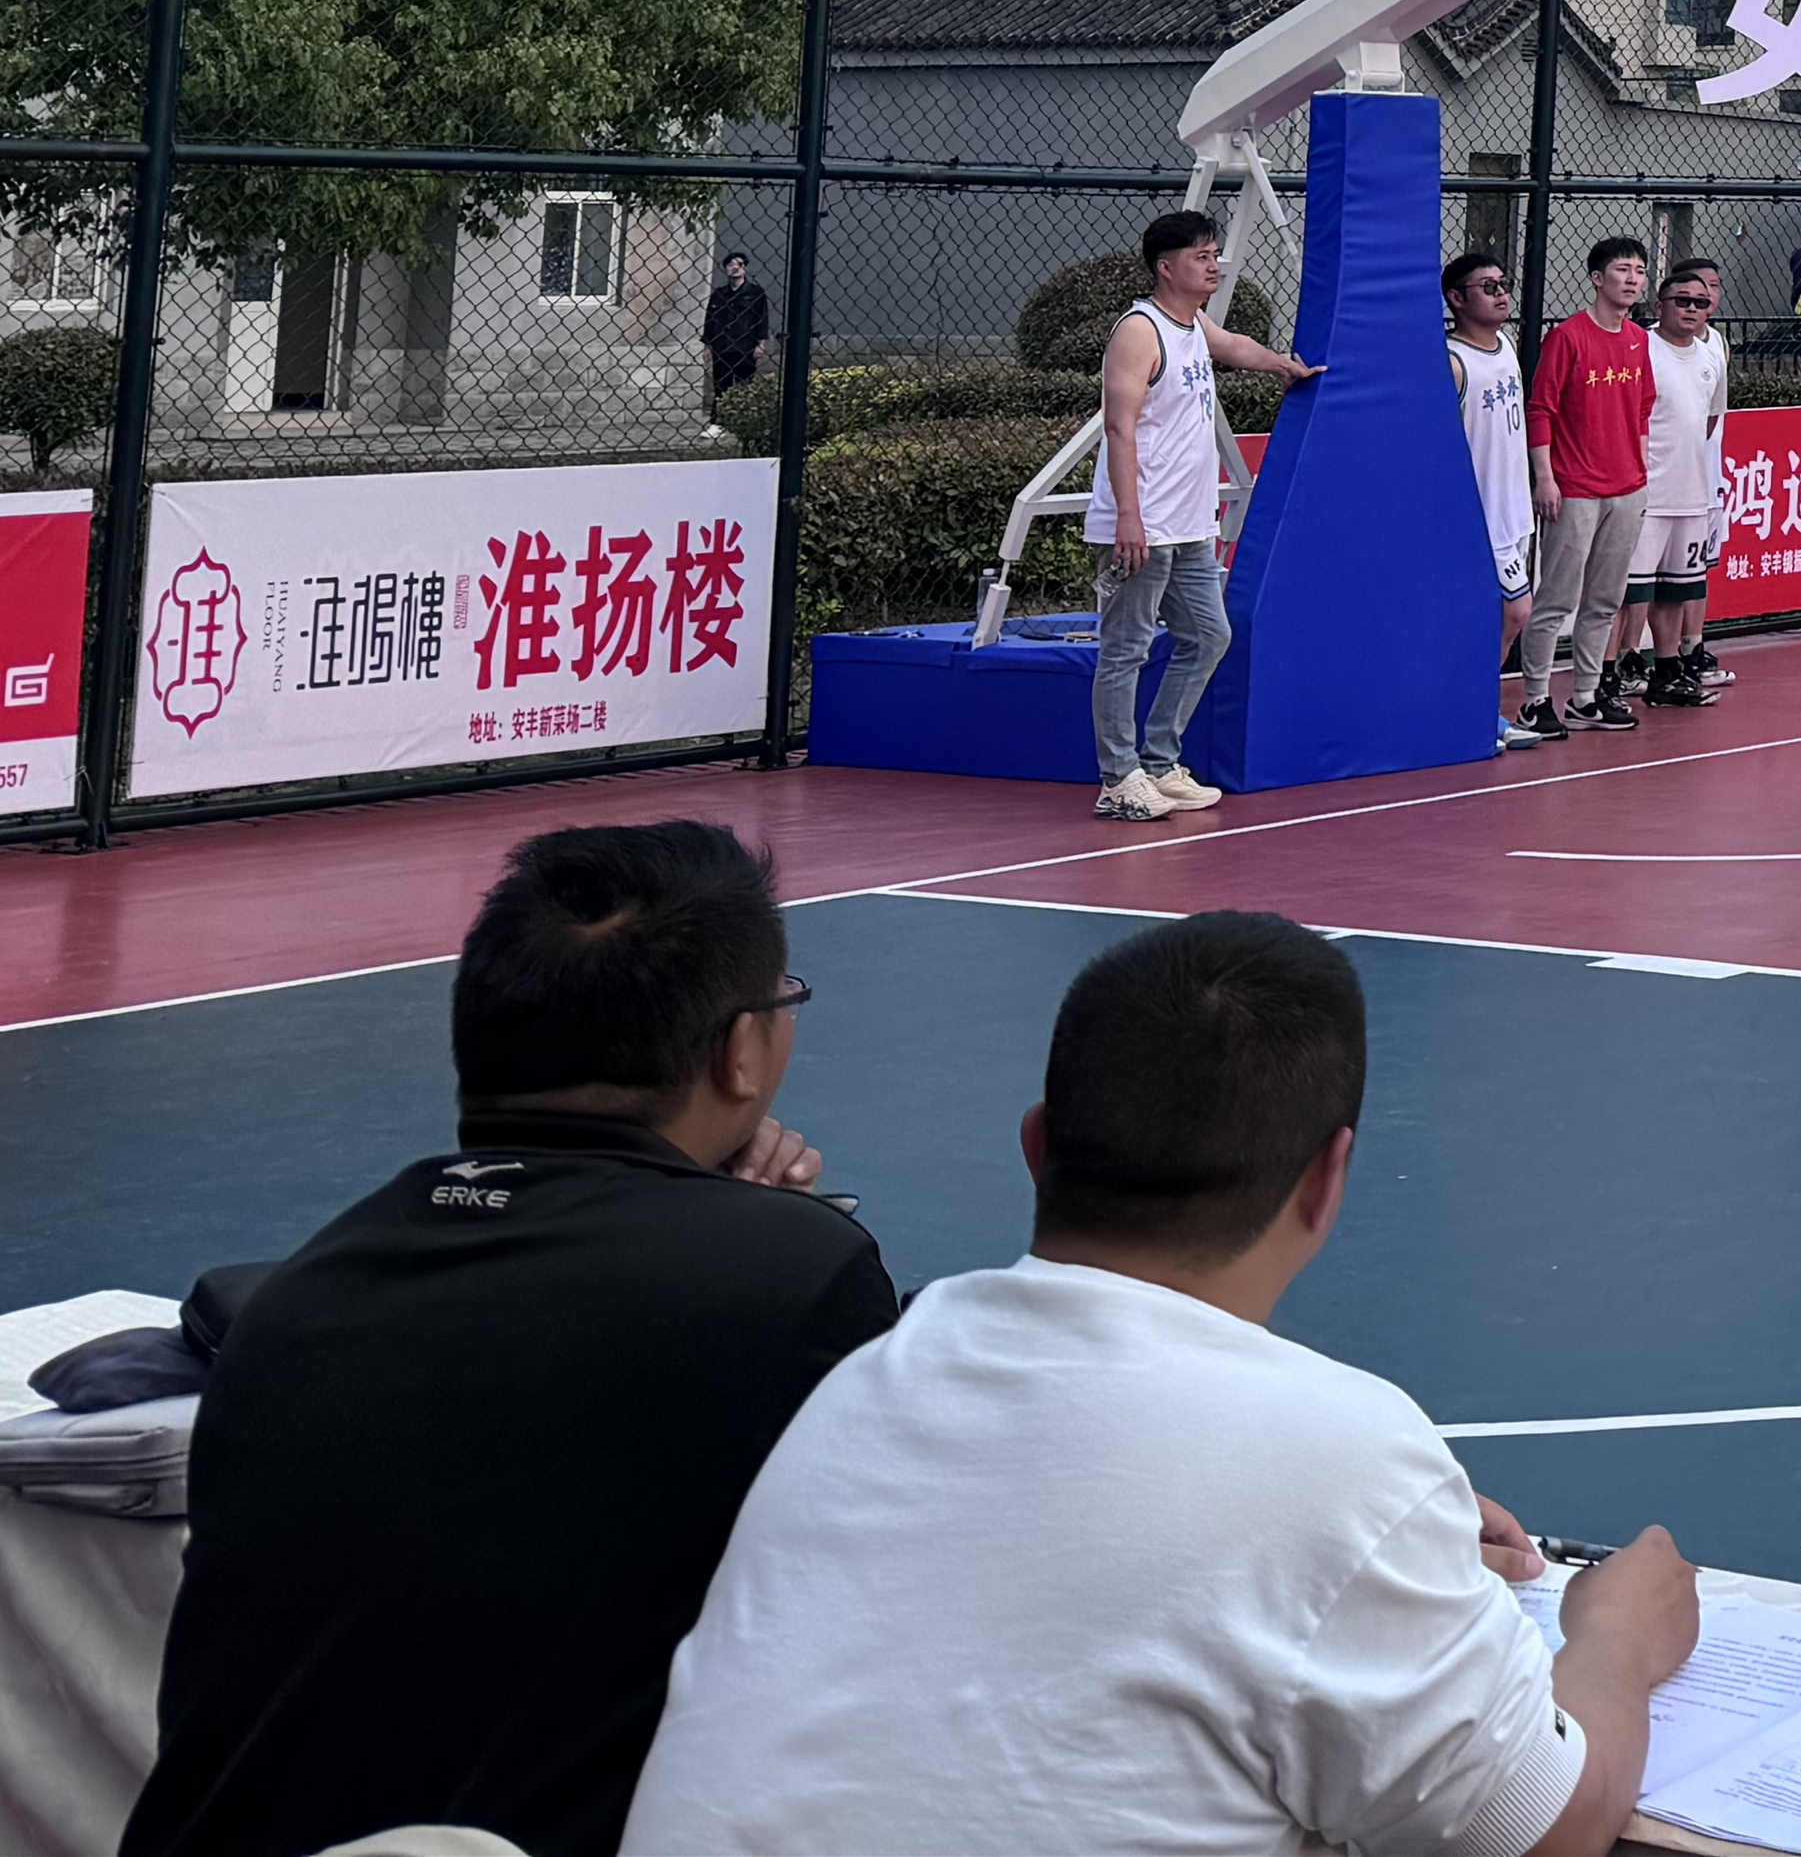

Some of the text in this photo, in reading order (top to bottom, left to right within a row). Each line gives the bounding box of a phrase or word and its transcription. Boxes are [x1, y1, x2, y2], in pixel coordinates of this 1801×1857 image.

[1482, 375, 1520, 412] 年丰水
[1506, 403, 1520, 435] 10
[474, 519, 745, 690] 淮扬楼
[431, 1185, 511, 1208] ERKE
